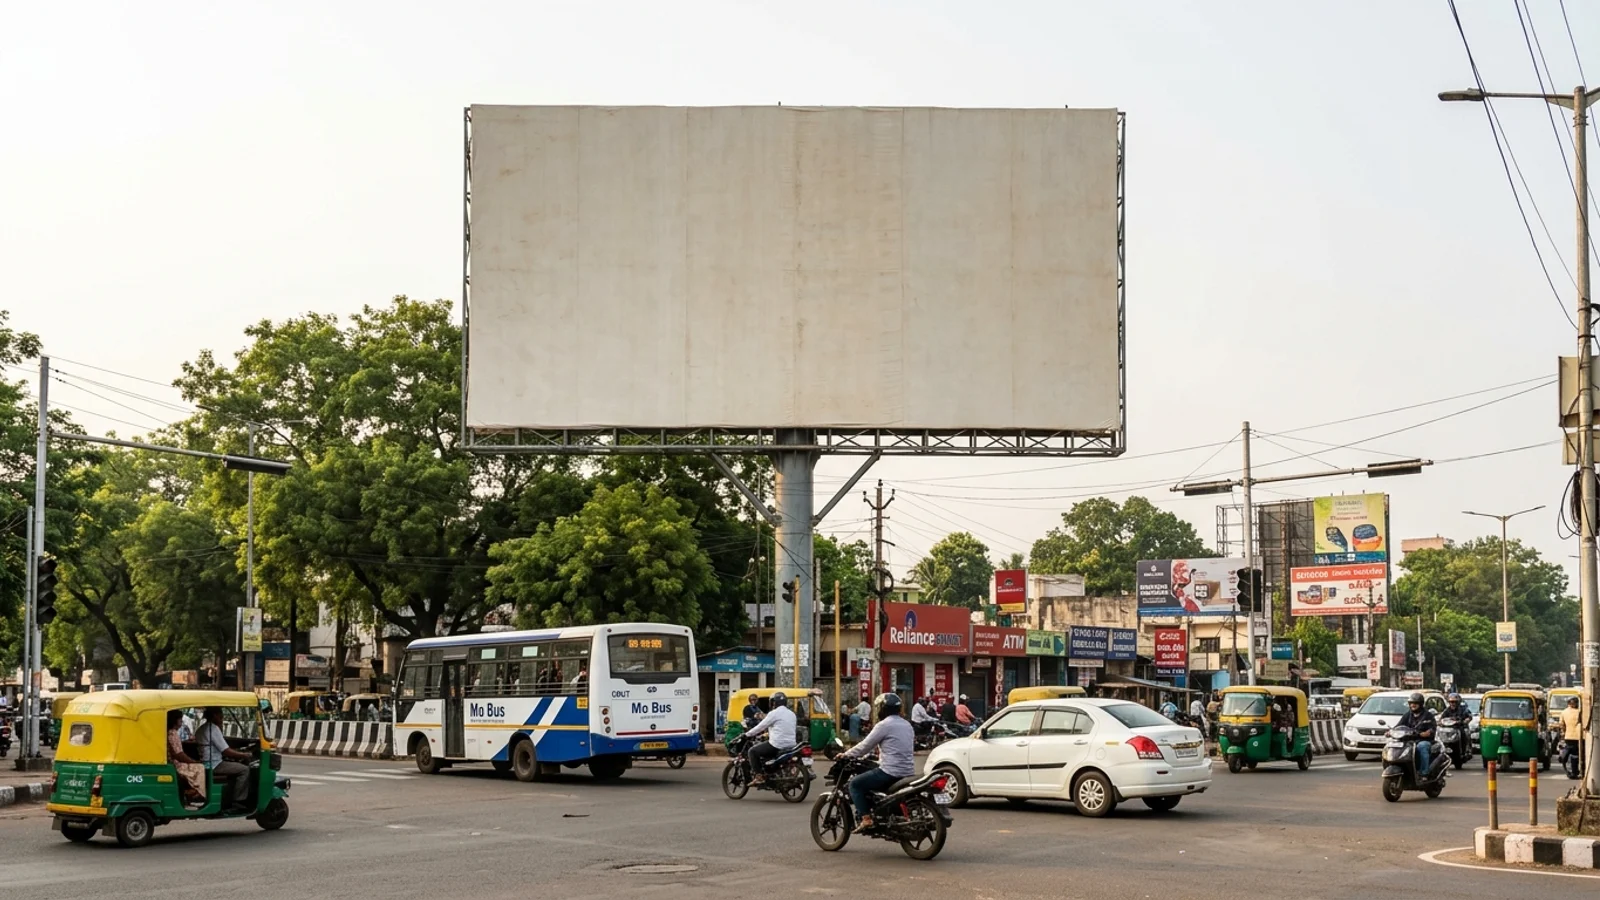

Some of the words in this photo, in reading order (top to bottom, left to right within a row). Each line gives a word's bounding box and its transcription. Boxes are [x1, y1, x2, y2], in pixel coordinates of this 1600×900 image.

[890, 626, 935, 646] Reliance
[470, 702, 484, 717] Mo
[487, 702, 505, 717] Bus
[631, 702, 648, 714] Mo
[651, 701, 672, 714] Bus
